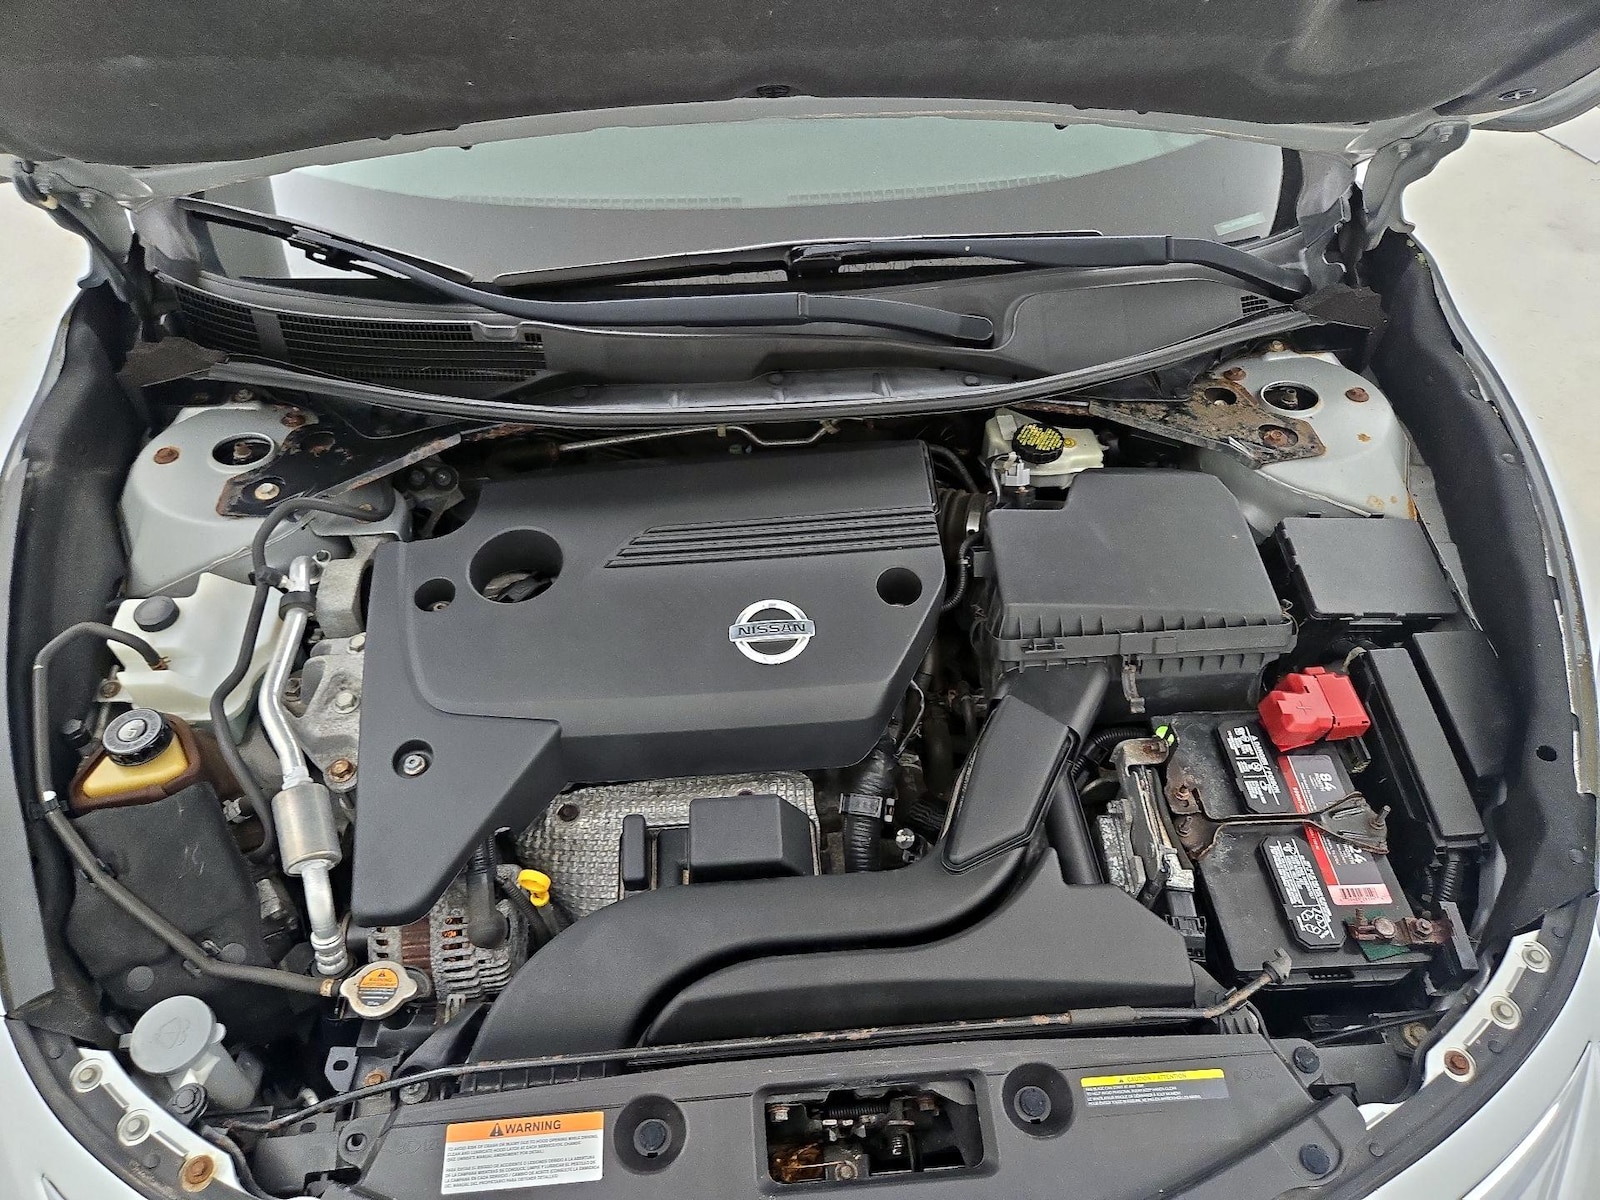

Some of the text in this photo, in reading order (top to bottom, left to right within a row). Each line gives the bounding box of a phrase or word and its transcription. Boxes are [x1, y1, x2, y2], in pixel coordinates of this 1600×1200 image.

[738, 622, 806, 636] NISSAN
[1320, 773, 1336, 792] 84
[1348, 846, 1368, 864] 24
[505, 1120, 562, 1134] WARNING
